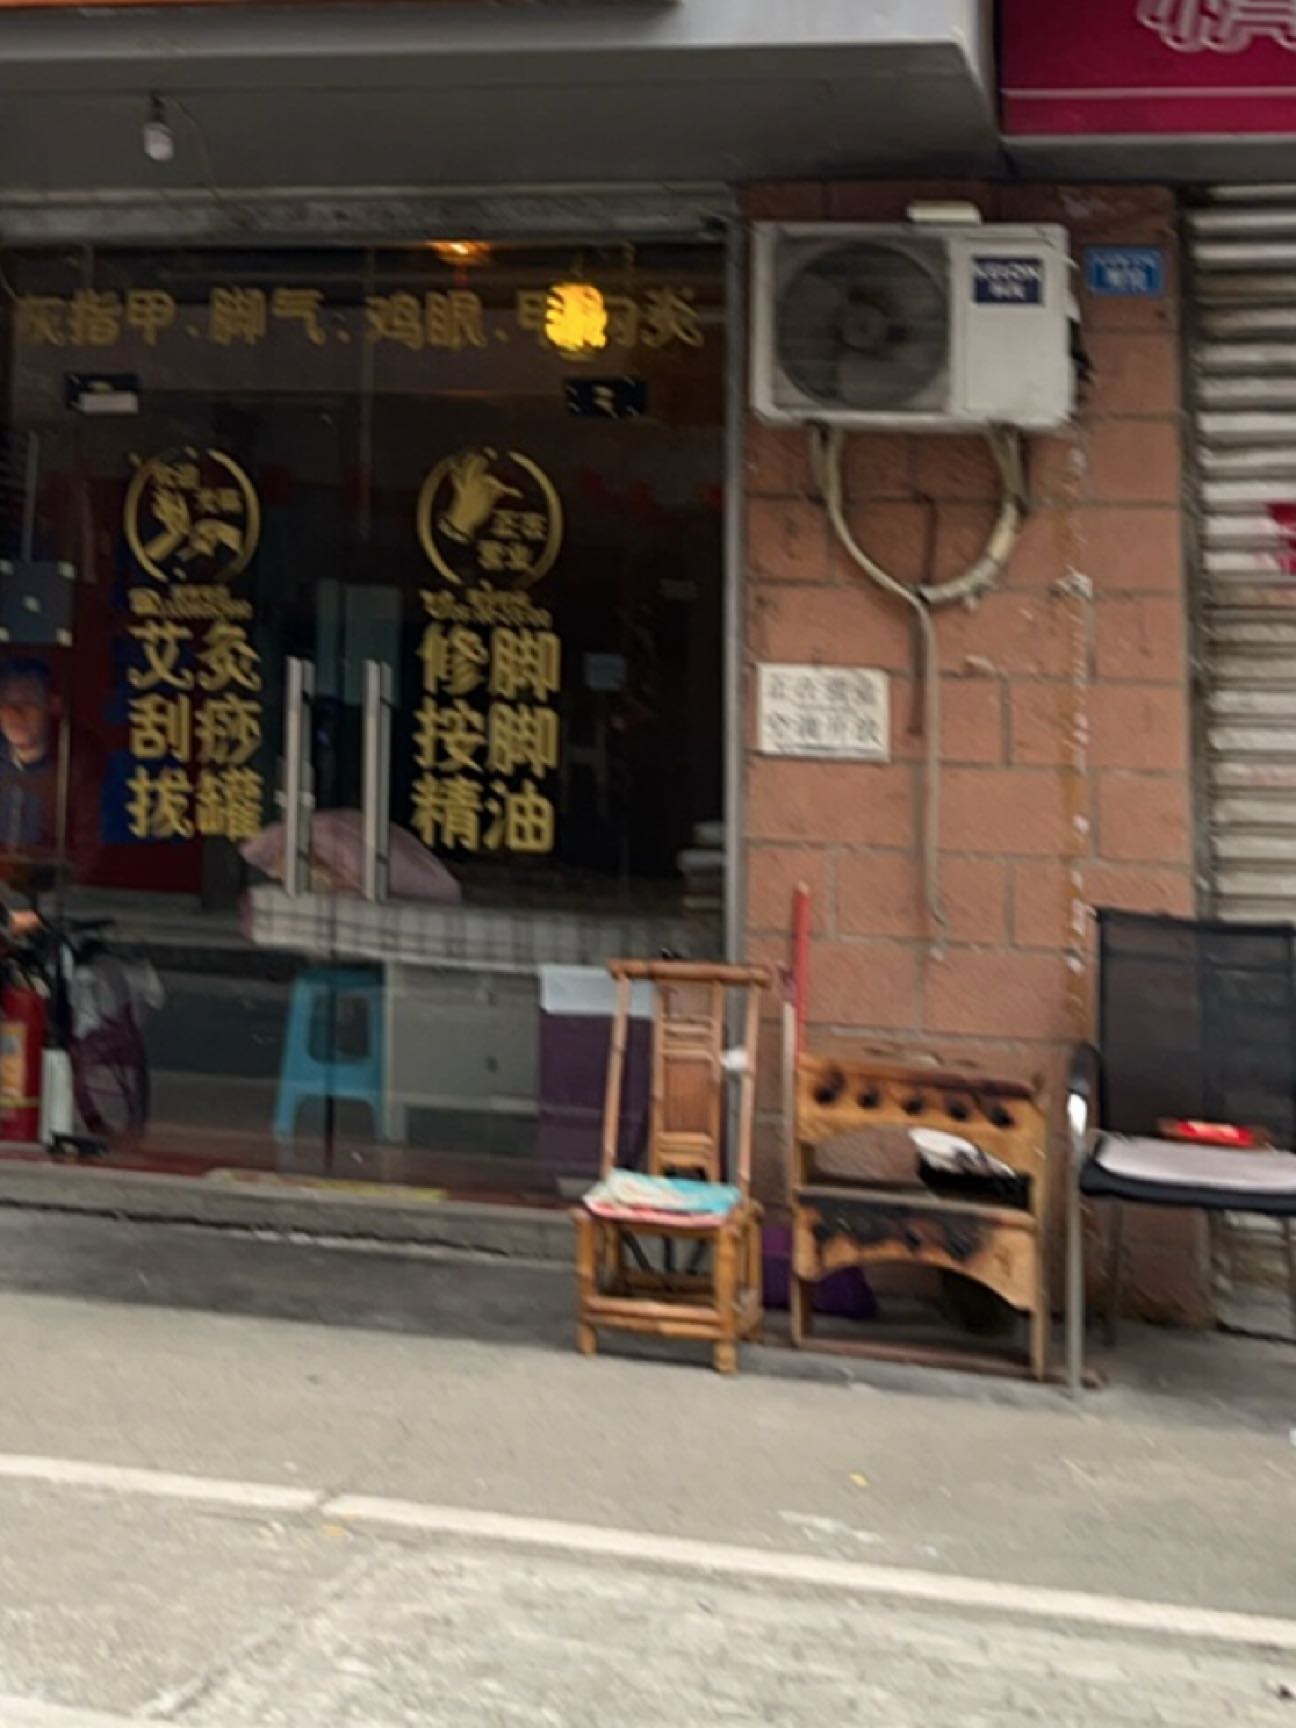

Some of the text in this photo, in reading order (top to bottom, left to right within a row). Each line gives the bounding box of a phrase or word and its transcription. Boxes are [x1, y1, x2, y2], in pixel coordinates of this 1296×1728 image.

[126, 693, 262, 767] 刮痧
[125, 766, 264, 840] 拔罐
[410, 774, 557, 854] 精油
